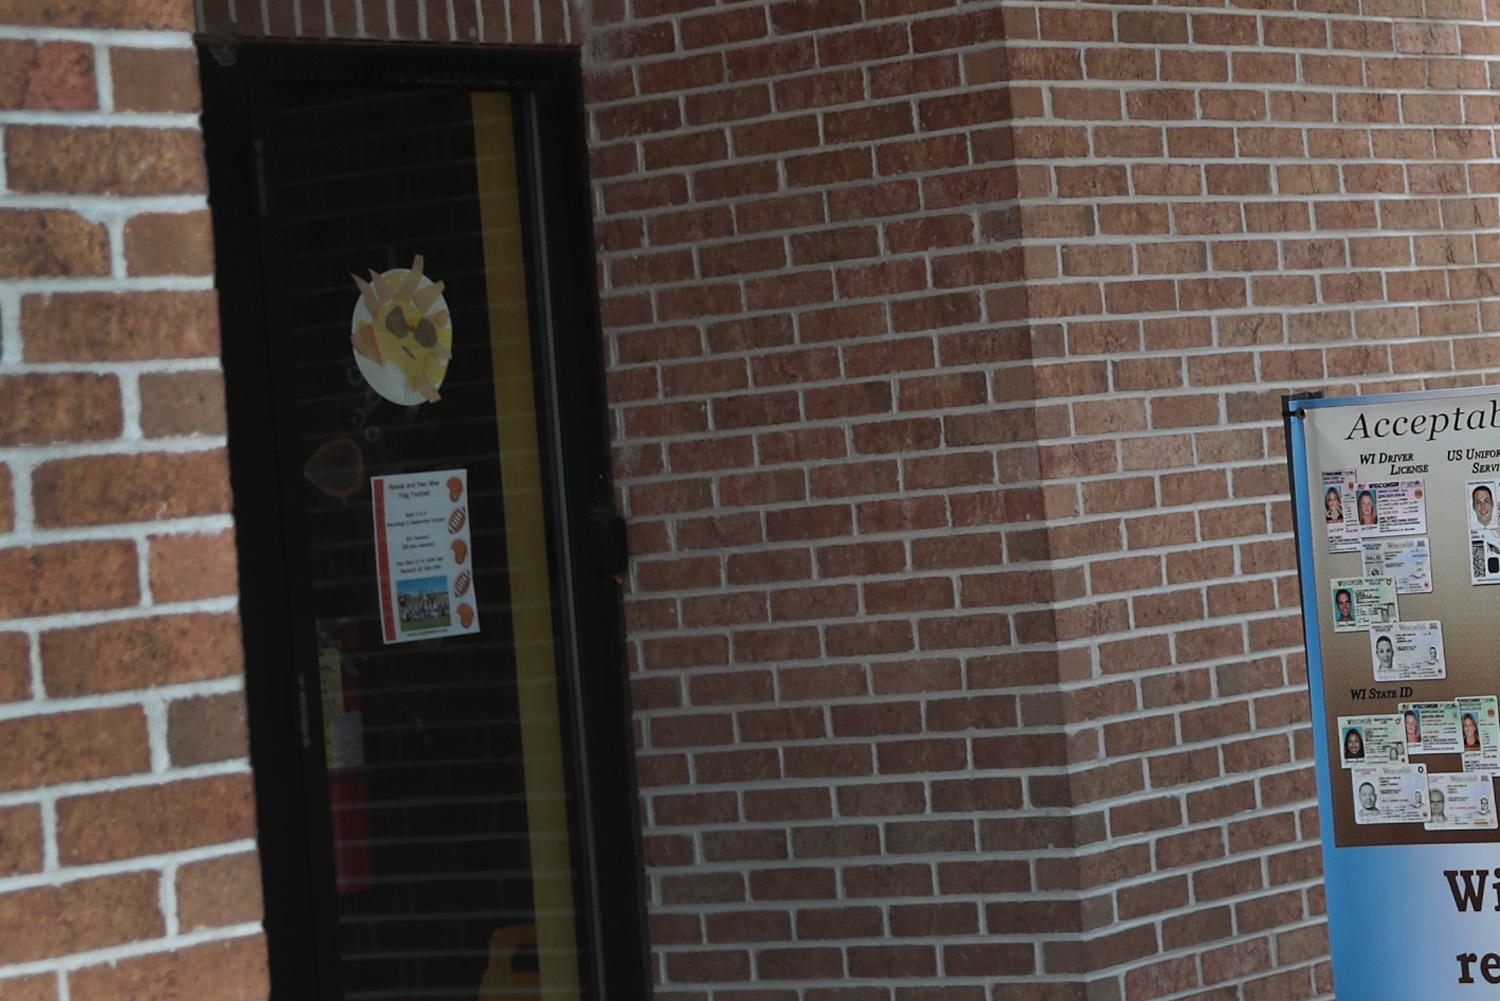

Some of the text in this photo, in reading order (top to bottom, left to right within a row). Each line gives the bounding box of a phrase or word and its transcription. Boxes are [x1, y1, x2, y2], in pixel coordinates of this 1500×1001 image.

[1359, 452, 1414, 465] WI DRIVER
[1447, 449, 1463, 461] US
[1390, 464, 1429, 475] LICENSE
[1350, 687, 1413, 700] WI STATE ID
